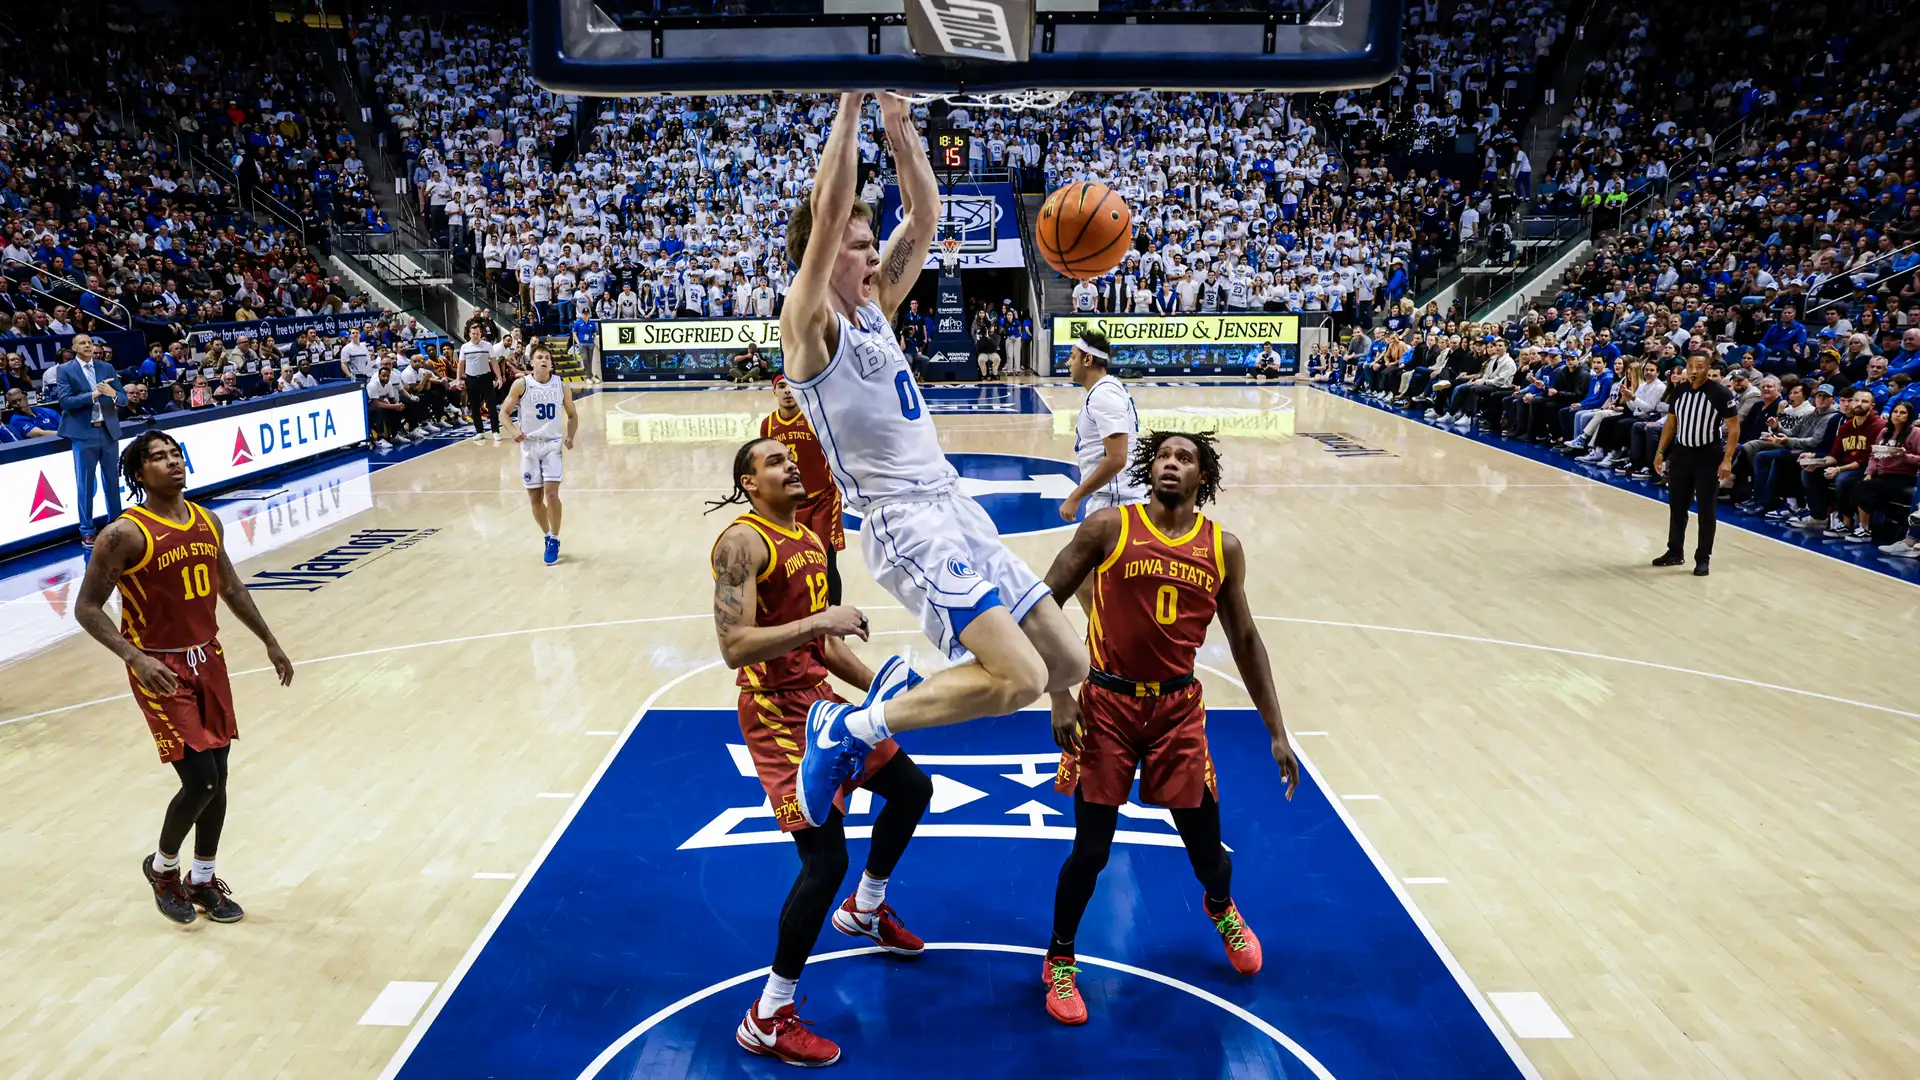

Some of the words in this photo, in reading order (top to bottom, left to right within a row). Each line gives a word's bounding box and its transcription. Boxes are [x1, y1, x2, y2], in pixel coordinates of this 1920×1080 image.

[939, 135, 963, 147] 18:16
[945, 147, 961, 166] 15
[222, 329, 233, 341] for
[233, 326, 258, 339] families
[275, 324, 288, 335] free
[338, 319, 349, 329] free
[644, 325, 734, 344] SIEGFRIED
[738, 325, 756, 343] &
[1097, 319, 1188, 339] SIEGFRIED
[1193, 320, 1210, 339] &
[1214, 319, 1283, 340] JENSEN
[894, 369, 921, 422] 0
[535, 403, 556, 420] 30
[259, 408, 337, 455] DELTA
[788, 431, 812, 441] STATE
[157, 545, 188, 571] IOWA
[243, 528, 419, 592] Marriott
[784, 551, 807, 579] IOWA
[180, 563, 211, 601] 10
[1124, 559, 1164, 580] IOWA
[1168, 561, 1214, 593] STATE
[805, 572, 828, 613] 12
[1155, 584, 1179, 625] 0
